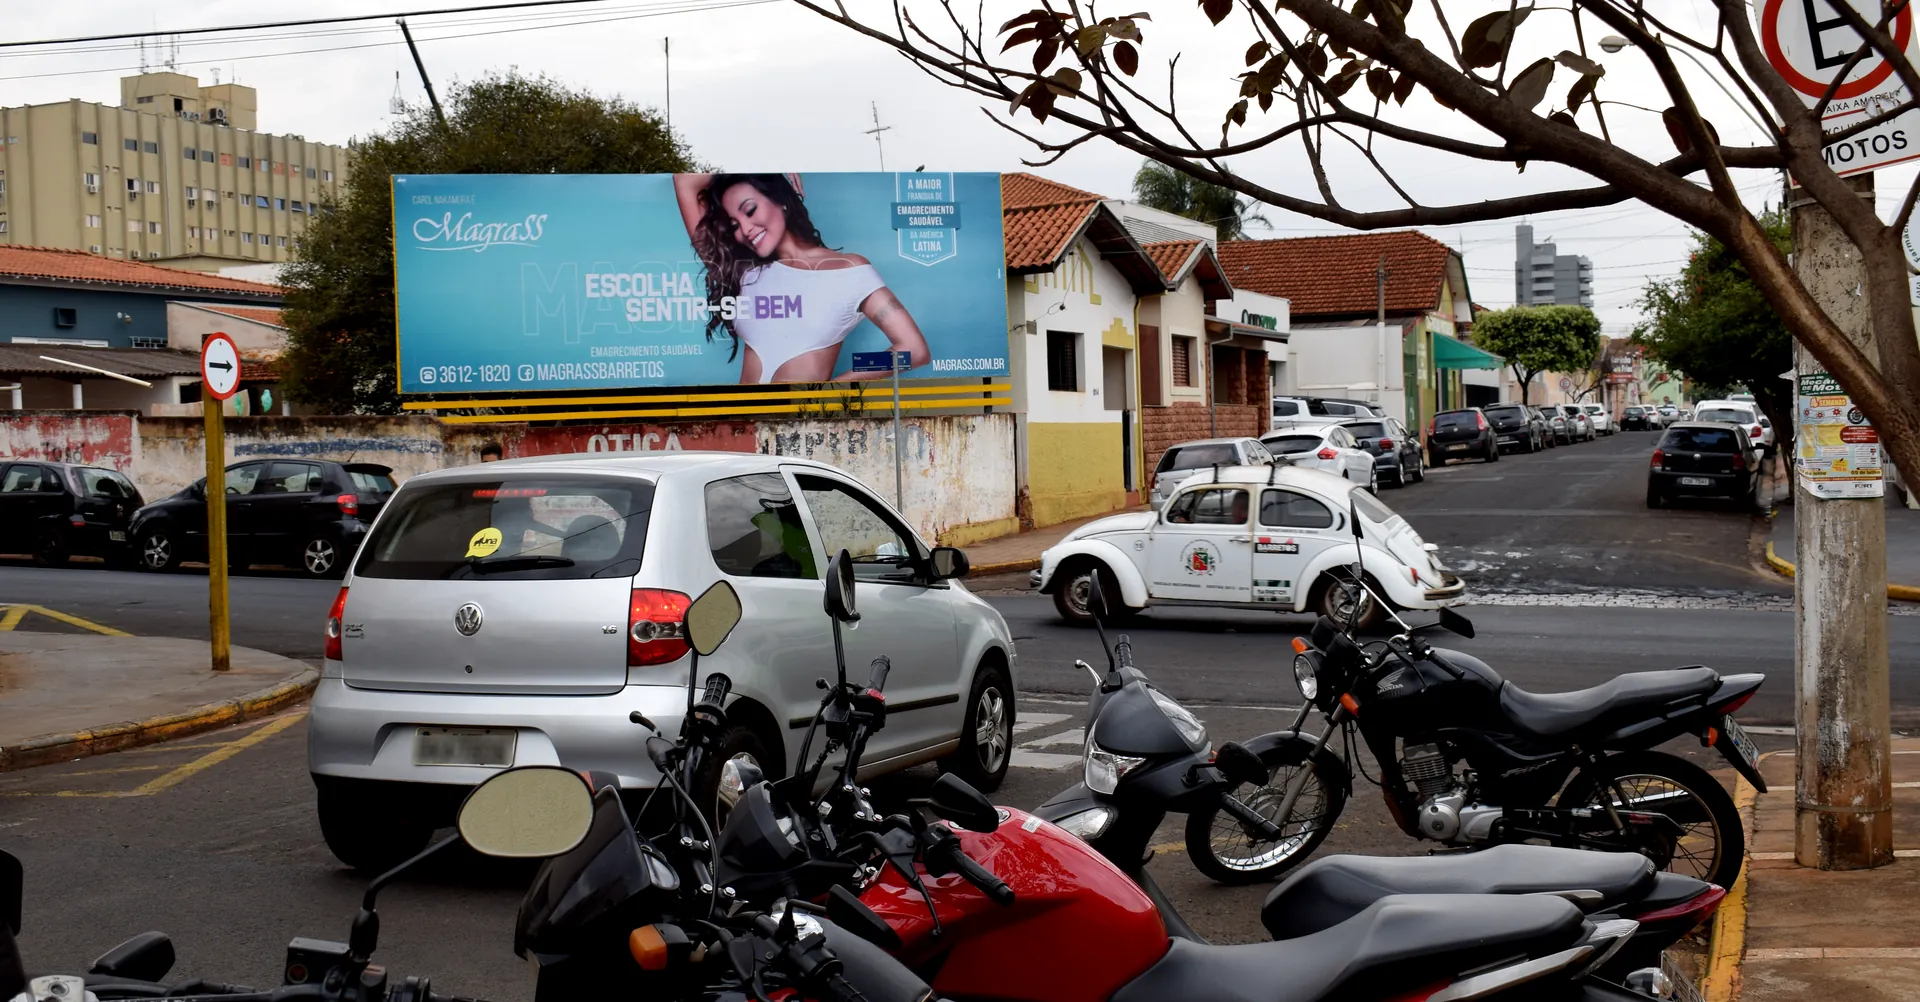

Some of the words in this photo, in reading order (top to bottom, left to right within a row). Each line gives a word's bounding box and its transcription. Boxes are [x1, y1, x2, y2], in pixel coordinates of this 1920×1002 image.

[1826, 102, 1850, 114] AIXA
[1825, 130, 1908, 165] MOTOS
[908, 179, 914, 190] A
[915, 178, 942, 190] MAIOR
[897, 205, 955, 215] EMAGRECIMENTO
[908, 215, 944, 226] SAUDÁVEL
[912, 241, 942, 252] LATINA
[585, 272, 695, 298] ESCOLHA
[625, 296, 751, 322] SENTIR-SE
[755, 295, 803, 319] BEM
[590, 346, 660, 357] EMAGRECIMENTO
[932, 357, 1005, 371] MAGRASS.COM.BR
[439, 364, 511, 383] 3612-1820
[537, 361, 665, 381] MAGRASSBARRETOS
[586, 427, 684, 453] ÓTICA
[1257, 543, 1297, 552] BARRETOS
